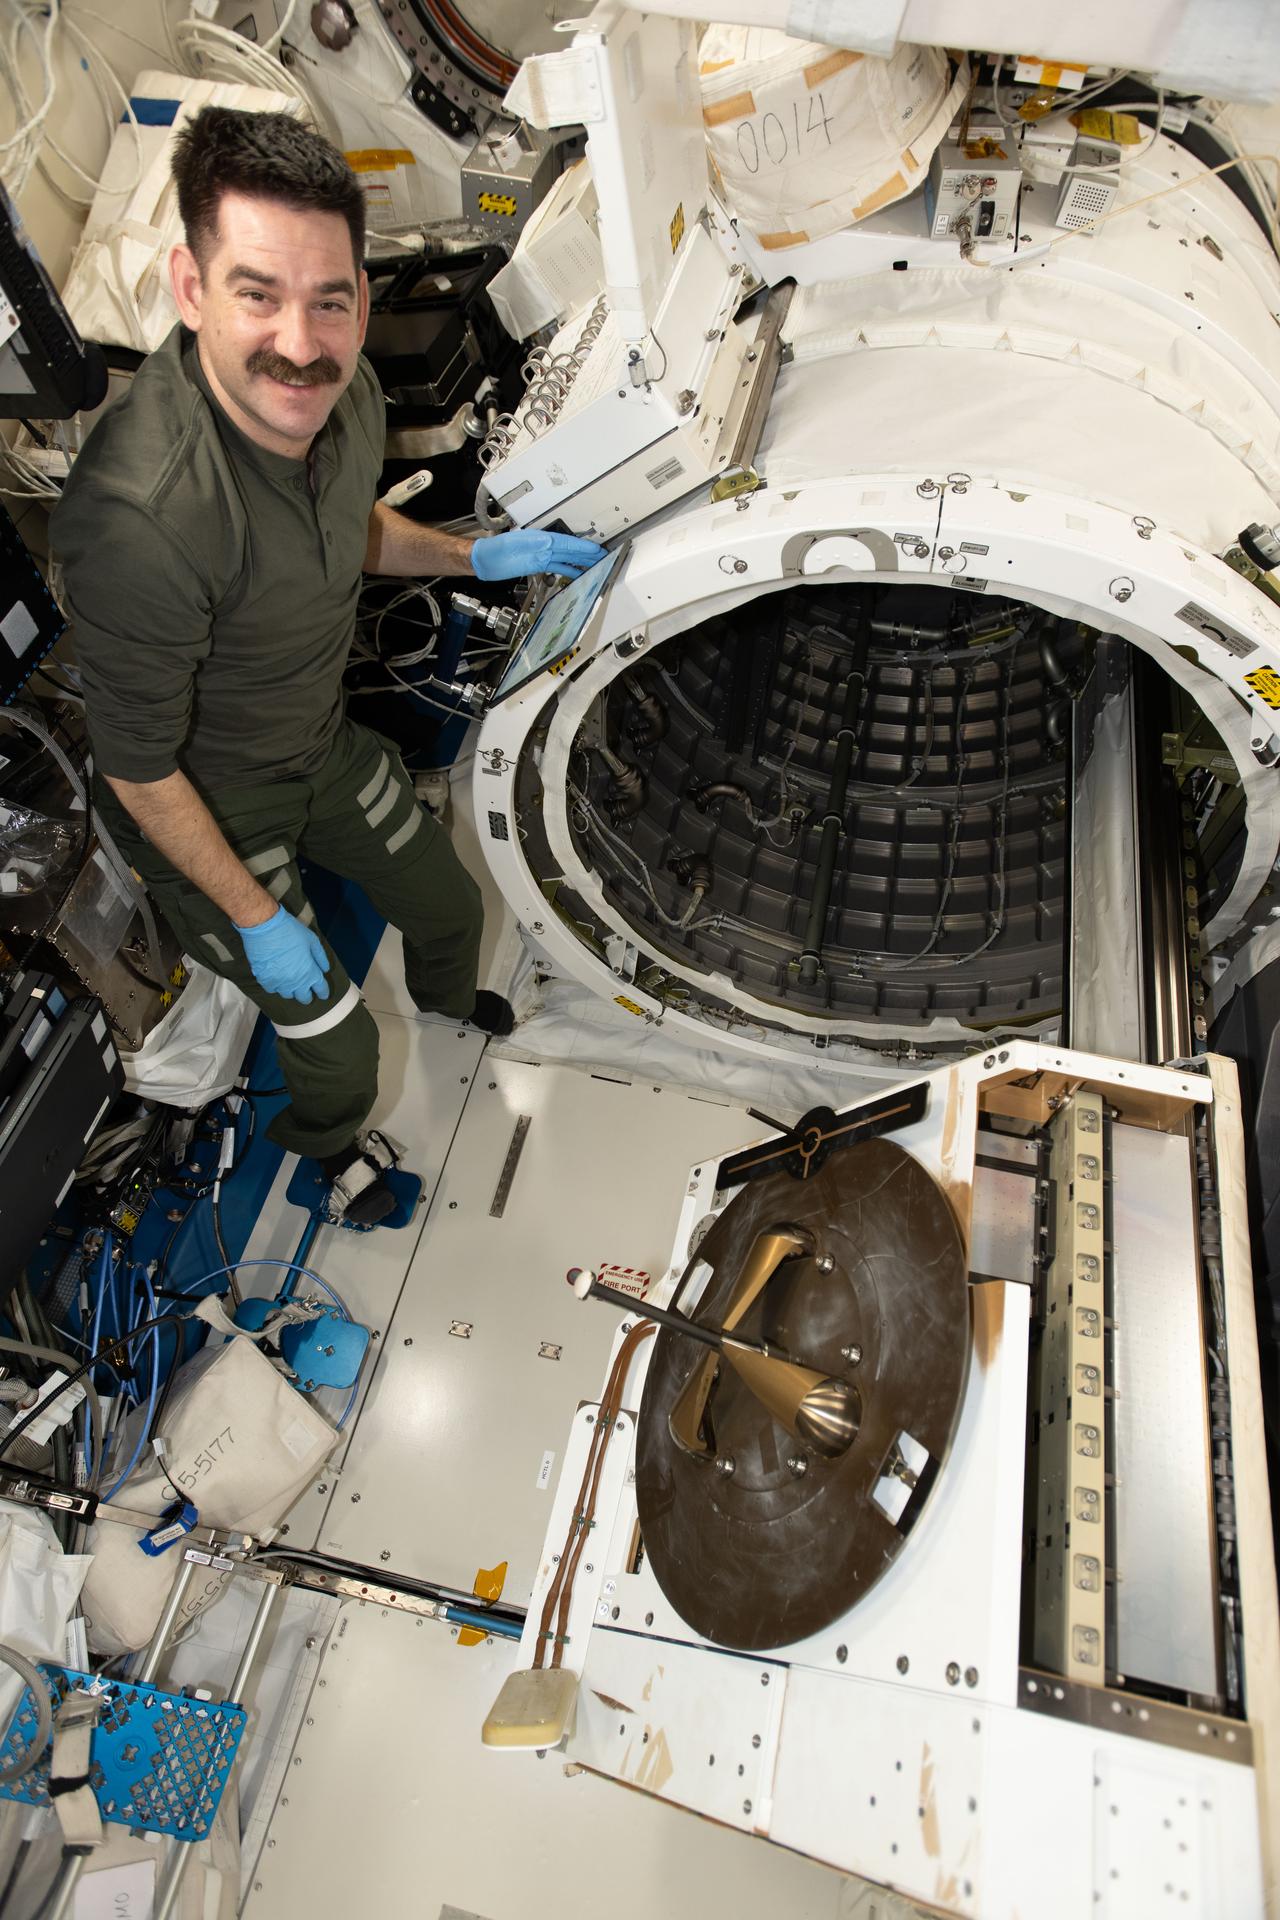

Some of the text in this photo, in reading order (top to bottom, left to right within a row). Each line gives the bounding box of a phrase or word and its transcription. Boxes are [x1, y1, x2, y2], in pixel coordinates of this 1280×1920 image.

[737, 92, 834, 173] 0014
[1262, 672, 1278, 688] CAUTION
[605, 1270, 633, 1281] EMERGENCY
[603, 1280, 641, 1294] FIRE PORT
